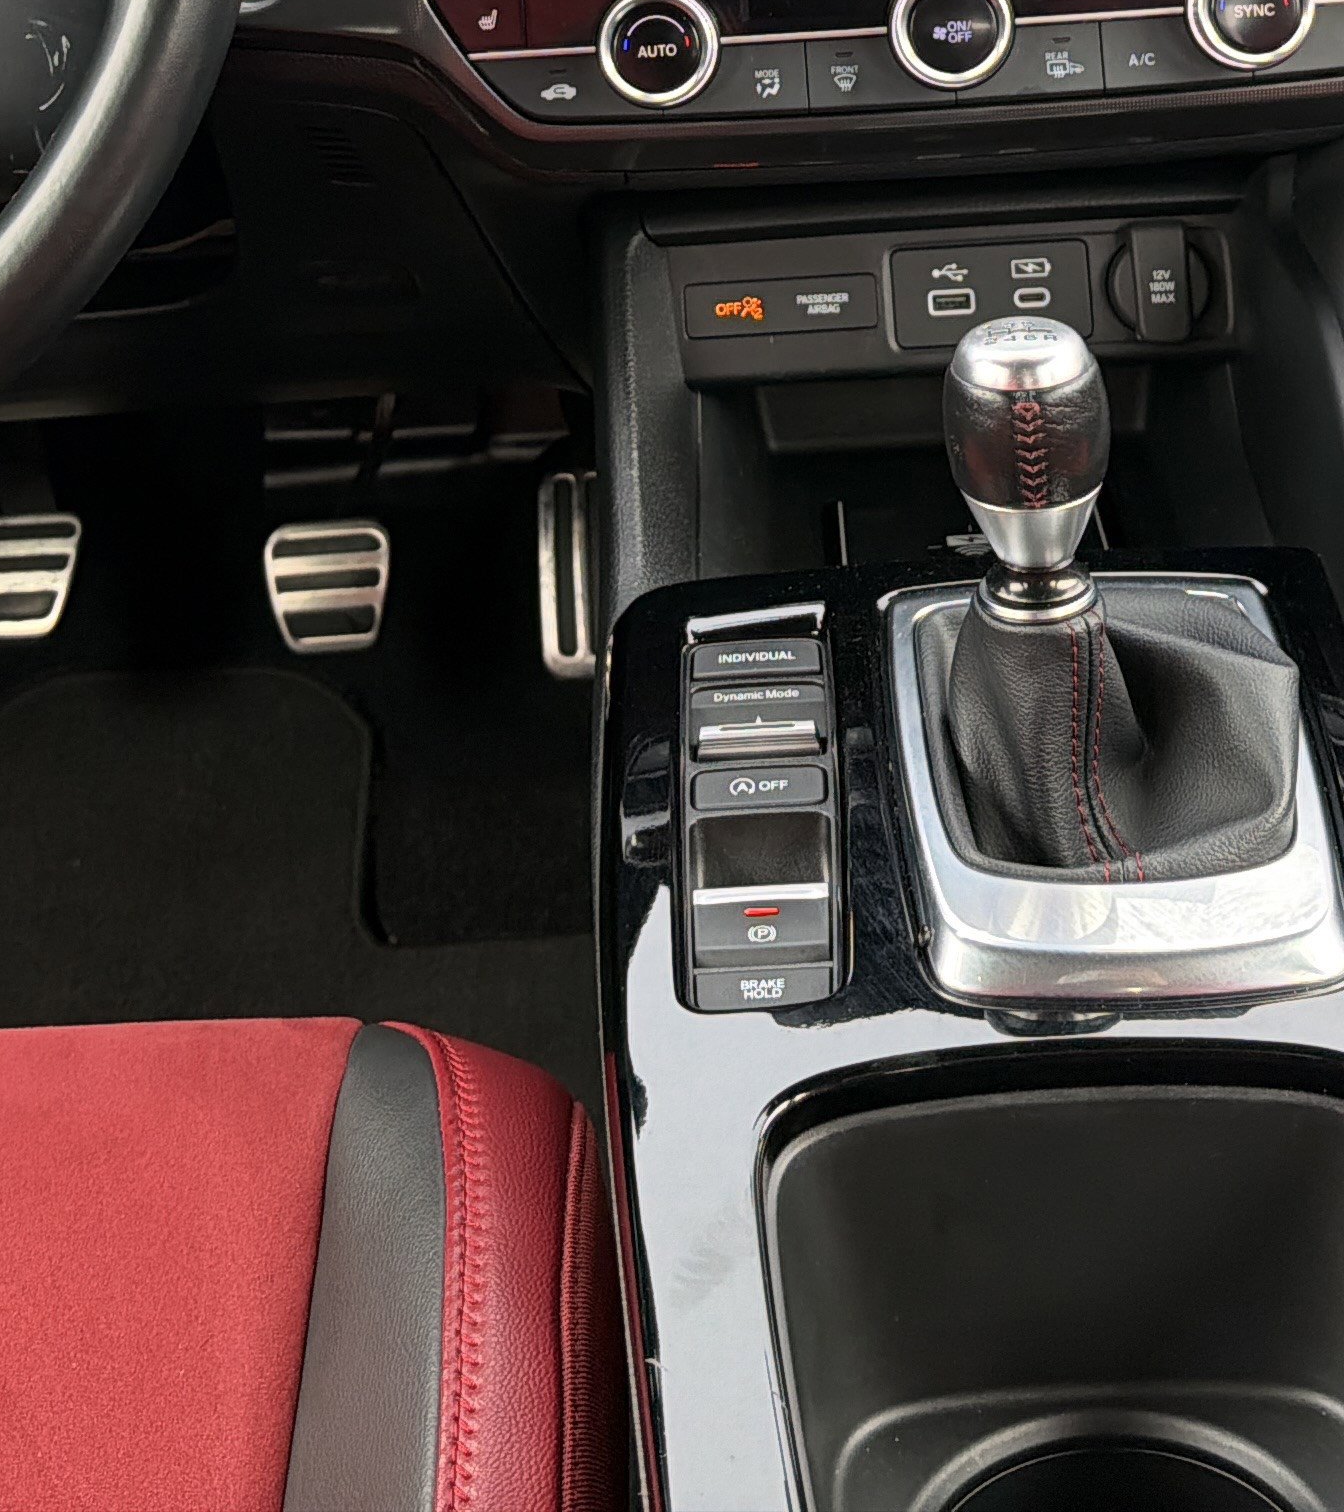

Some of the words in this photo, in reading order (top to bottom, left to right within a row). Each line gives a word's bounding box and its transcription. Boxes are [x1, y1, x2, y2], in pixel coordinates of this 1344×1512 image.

[1234, 3, 1276, 18] SYNC
[947, 20, 972, 30] ON/
[948, 31, 973, 43] OFF
[638, 44, 677, 59] AUTO
[1045, 51, 1068, 61] REAR
[1129, 52, 1155, 67] A/C
[755, 69, 779, 78] MODE
[831, 65, 858, 74] FRONT
[1153, 270, 1170, 280] 12V
[796, 293, 849, 304] PASSENGER
[1151, 293, 1176, 303] MAX
[715, 302, 742, 316] OFF
[807, 304, 840, 314] AIRBAG
[718, 650, 796, 664] INDIVIDUAL
[713, 691, 764, 703] Dynamic
[765, 688, 800, 700] Mode
[759, 779, 789, 792] OFF
[740, 978, 785, 991] BRAKE
[743, 987, 783, 999] HOLD
